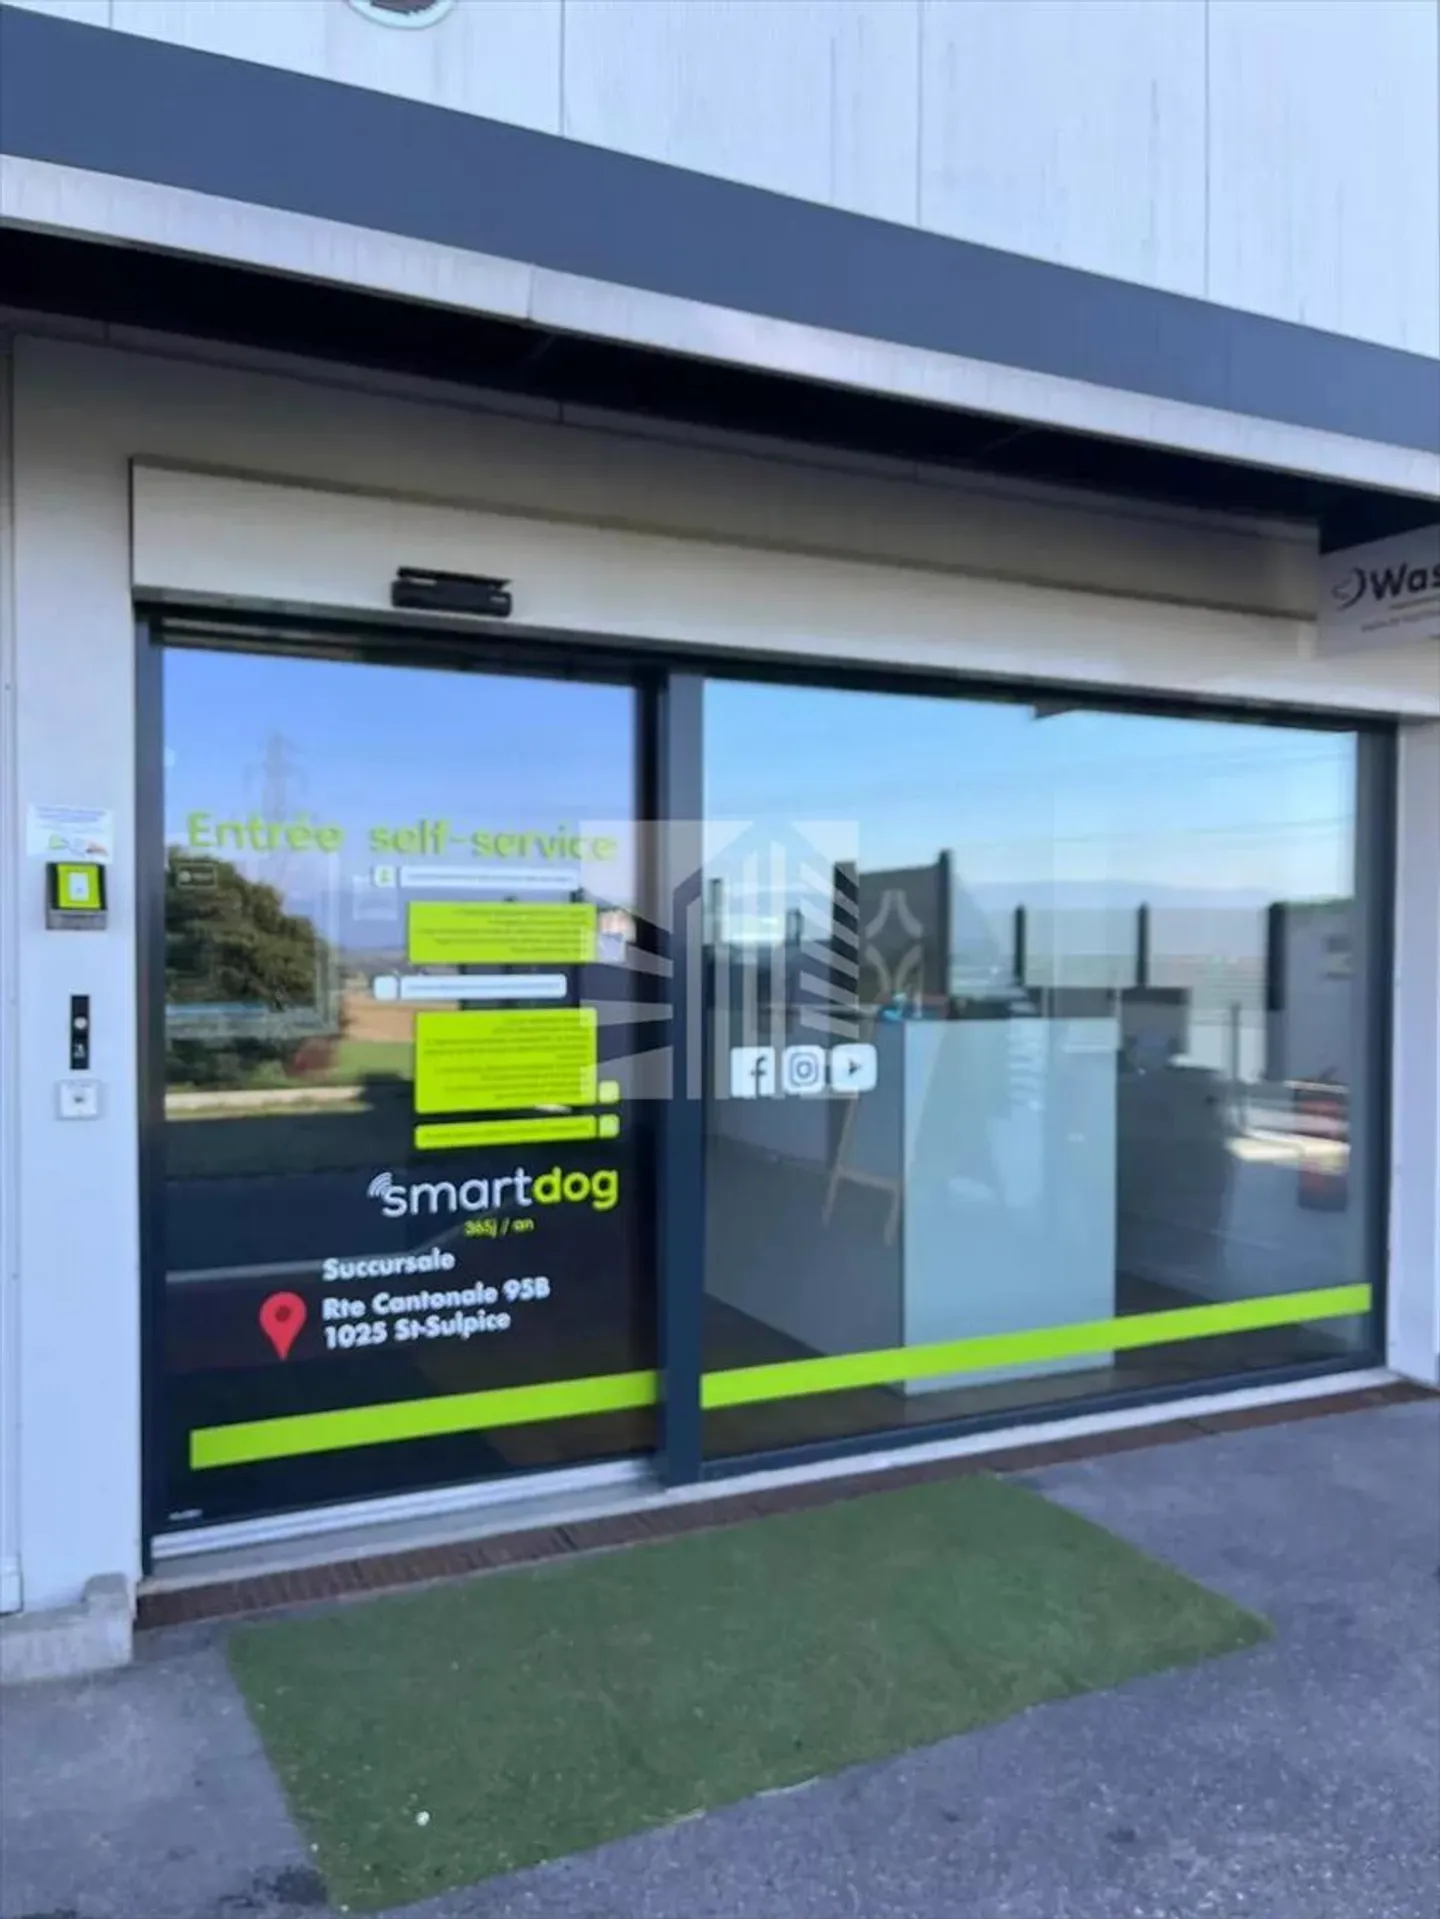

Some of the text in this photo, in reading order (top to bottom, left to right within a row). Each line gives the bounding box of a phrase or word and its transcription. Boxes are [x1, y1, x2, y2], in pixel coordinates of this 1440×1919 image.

[186, 811, 617, 861] Entrée self-service
[381, 1167, 619, 1217] smartdog
[322, 1247, 456, 1281] Succursale
[322, 1276, 551, 1321] Rte Cantonale 95B
[324, 1309, 512, 1350] 1025 St-Sulpice
